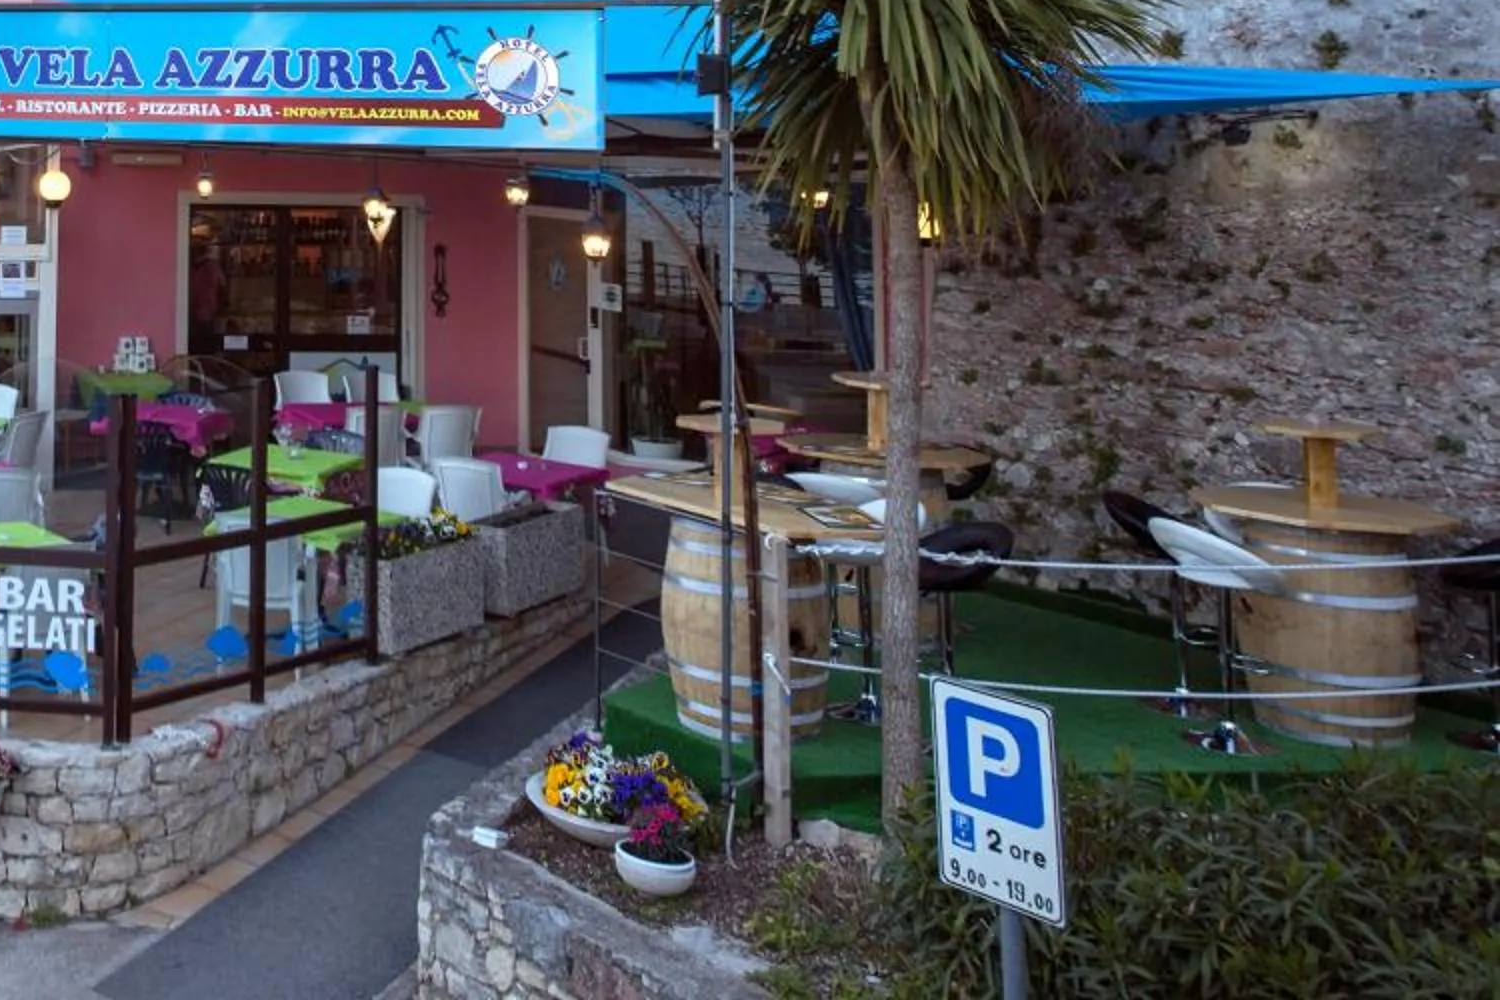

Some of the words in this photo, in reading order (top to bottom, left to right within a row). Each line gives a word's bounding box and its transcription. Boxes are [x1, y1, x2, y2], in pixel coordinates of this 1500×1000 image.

[499, 38, 549, 62] HOTEL
[155, 49, 449, 91] AZZURRA
[15, 99, 127, 115] RISTORANTE
[138, 102, 222, 118] PIZZERIA
[234, 103, 273, 118] BAR
[283, 106, 481, 121] INFO@VELAAZZURRA.COM
[965, 715, 1021, 798] P
[986, 829, 1003, 853] 2
[1009, 844, 1048, 869] ore
[950, 858, 987, 888] 9.00
